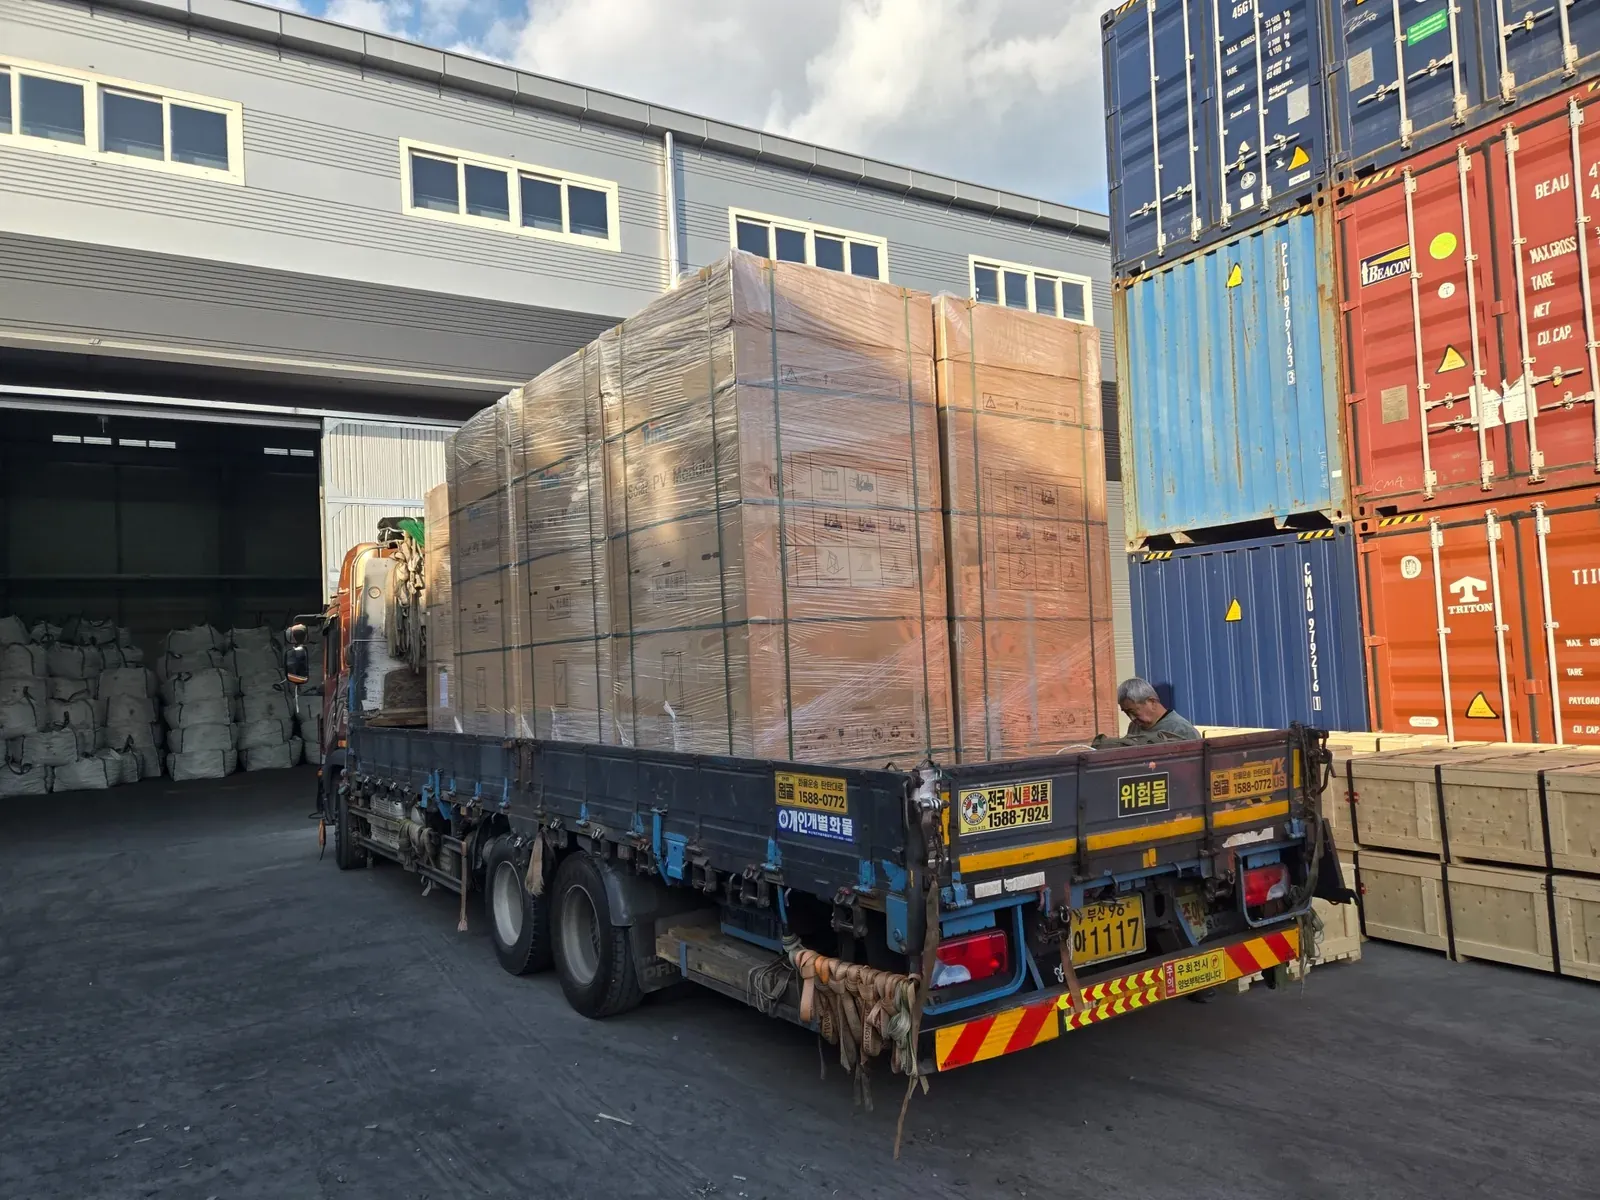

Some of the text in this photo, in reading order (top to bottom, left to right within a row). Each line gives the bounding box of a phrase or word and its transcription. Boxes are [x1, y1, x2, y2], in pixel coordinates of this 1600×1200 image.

[1232, 0, 1253, 19] 45G1
[1534, 173, 1570, 200] BEAU
[1368, 258, 1411, 284] BEACON
[1531, 270, 1555, 292] TARE
[1281, 242, 1295, 384] PCIU 879163 3
[1534, 301, 1552, 318] NET
[1537, 324, 1573, 346] CU. CAP.
[1304, 562, 1313, 612] CMAU
[1572, 568, 1600, 586] TII
[1448, 602, 1493, 615] TRITON
[1308, 618, 1320, 692] 979216
[1568, 696, 1600, 705] PAYLOAD
[1120, 780, 1167, 809] 위험물
[1233, 779, 1272, 794] 1588-0772
[798, 790, 845, 808] 1588-0772
[788, 810, 852, 836] 개인개별화물
[988, 806, 1049, 828] 1588-7924
[1087, 907, 1105, 922] 부산
[1073, 917, 1139, 955] 아1117
[1177, 957, 1209, 976] 우회전시
